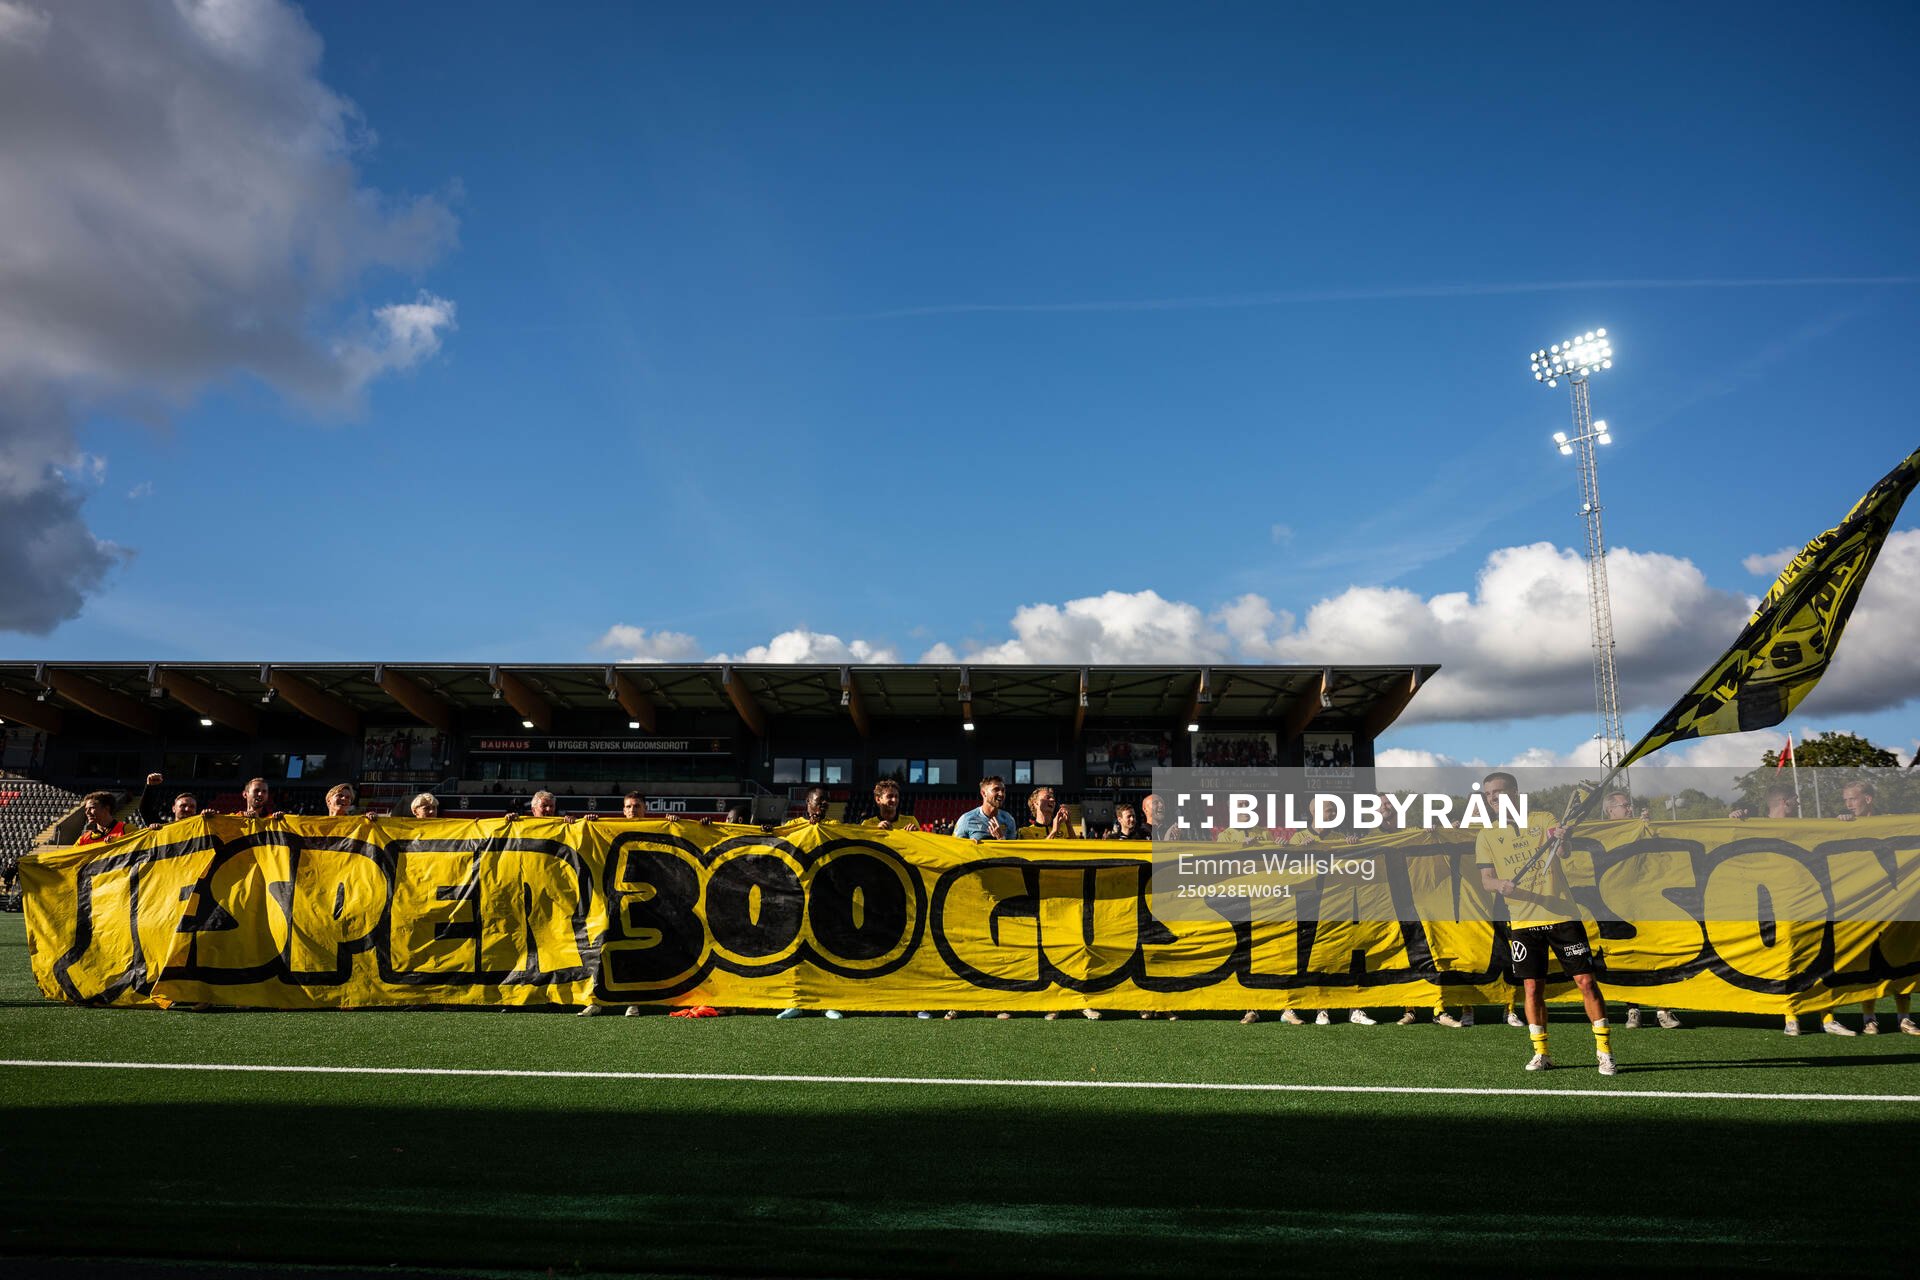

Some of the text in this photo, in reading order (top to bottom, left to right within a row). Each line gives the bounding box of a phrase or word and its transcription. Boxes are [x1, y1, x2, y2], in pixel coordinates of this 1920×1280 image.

[480, 740, 530, 749] BAUHAUS
[547, 740, 689, 750] VI BYGGER SVENSK UNGDOMSIDROTT
[646, 799, 687, 812] dium
[594, 832, 932, 1000] 300
